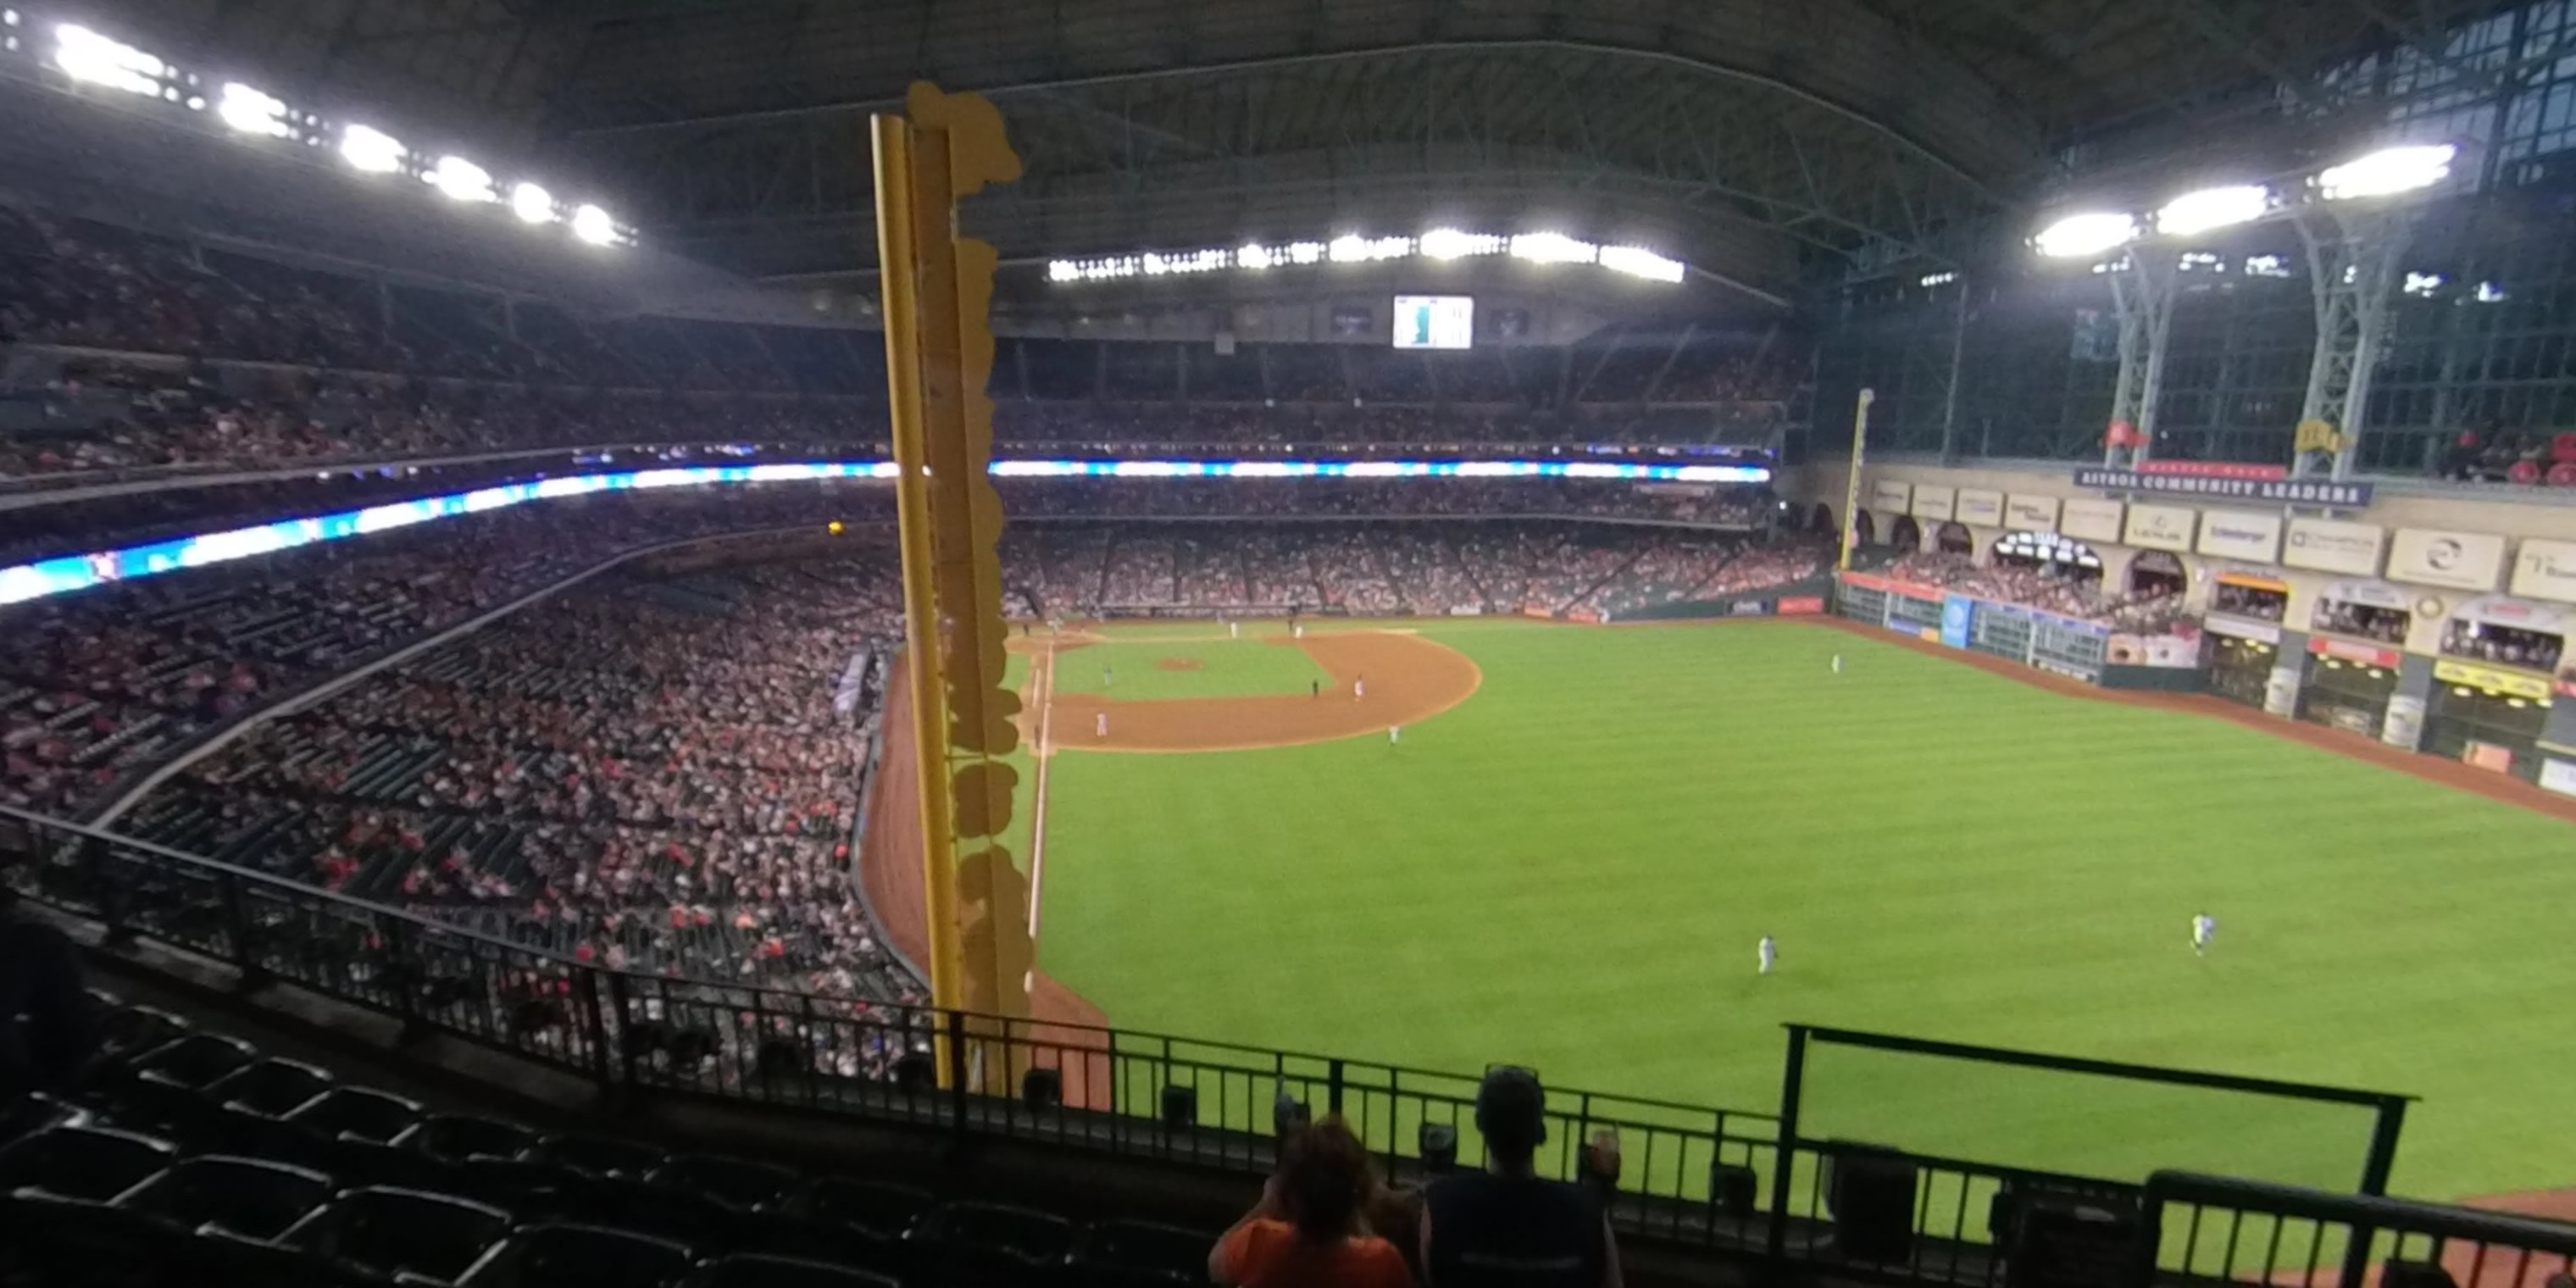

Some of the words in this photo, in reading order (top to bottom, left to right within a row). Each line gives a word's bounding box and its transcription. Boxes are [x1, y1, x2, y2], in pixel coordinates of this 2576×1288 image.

[2081, 472, 2138, 486] ASTROS
[2142, 475, 2255, 495] COMMUNITY
[2262, 482, 2359, 503] LEADERS
